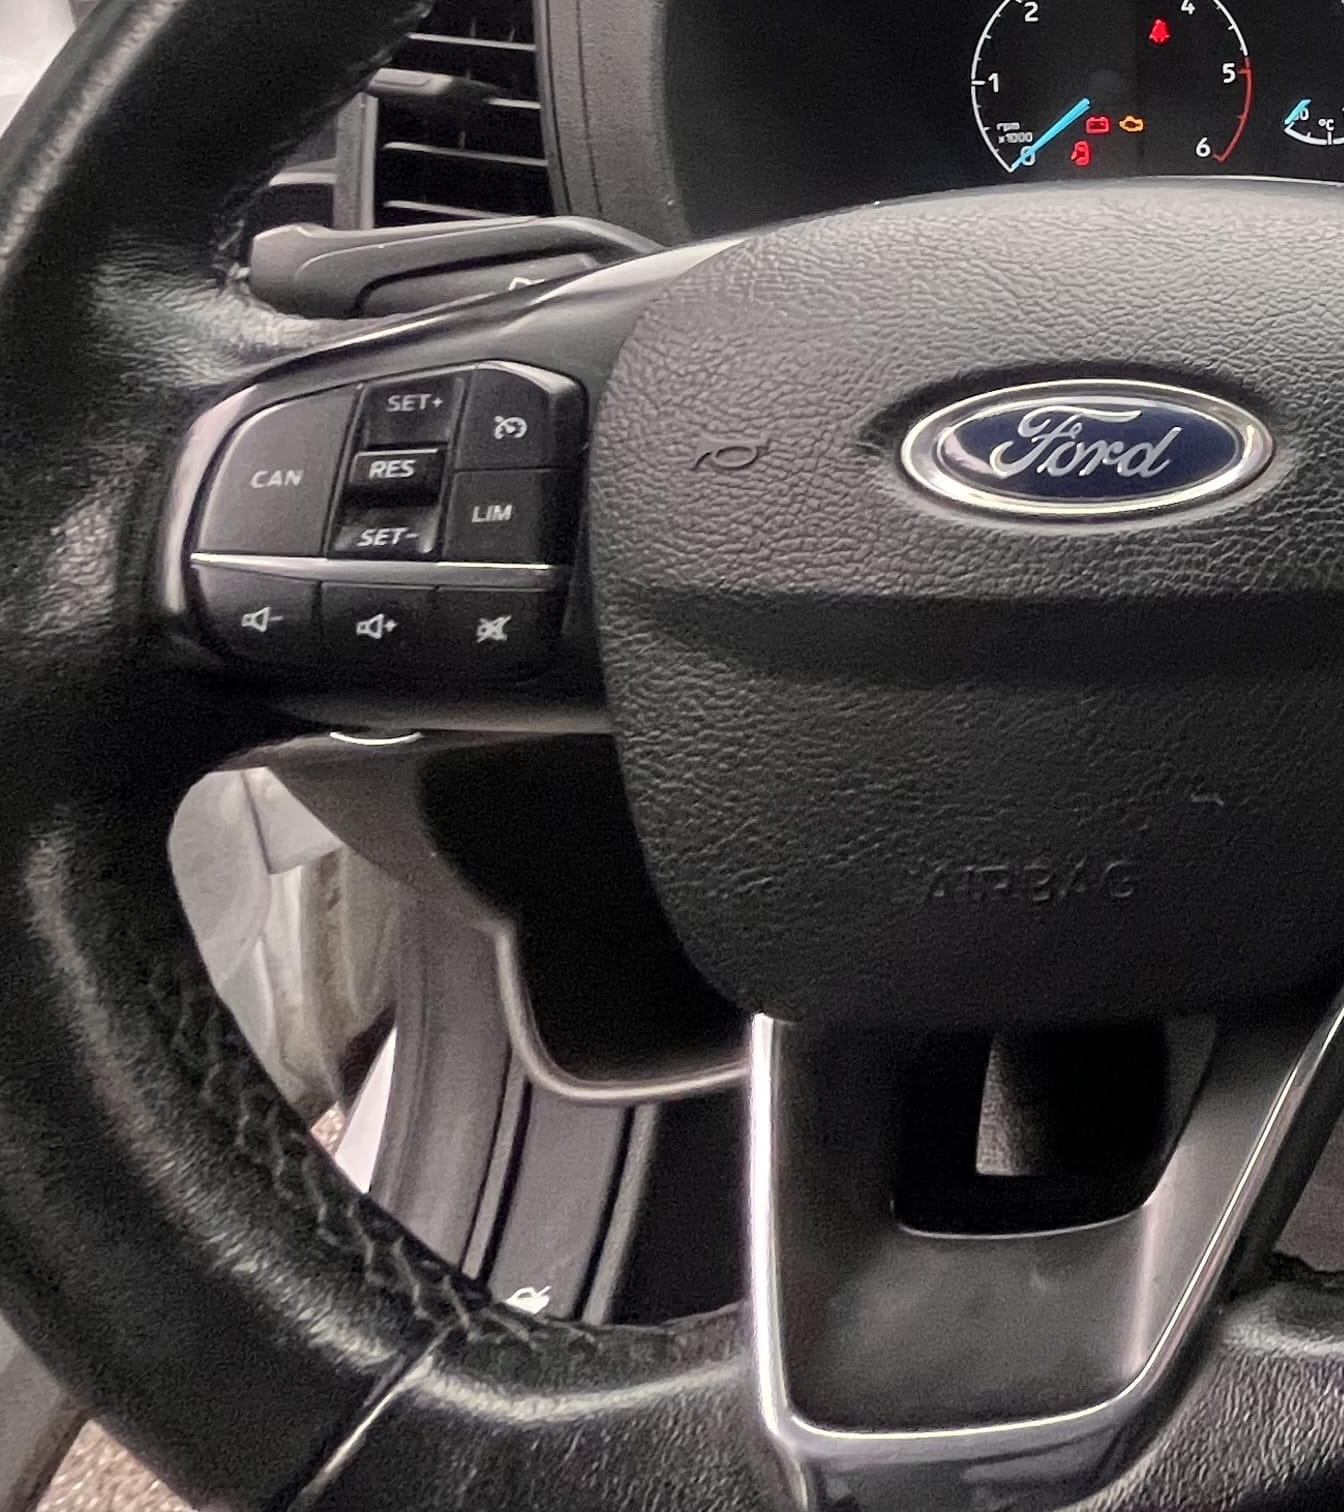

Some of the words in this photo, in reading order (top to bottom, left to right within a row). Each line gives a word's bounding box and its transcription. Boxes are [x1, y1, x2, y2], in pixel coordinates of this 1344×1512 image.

[1023, 1, 1039, 22] 2
[987, 72, 999, 93] 1
[1222, 62, 1236, 83] 5
[1020, 145, 1036, 166] 0
[1196, 137, 1211, 157] 6
[989, 404, 1183, 479] Ford
[251, 469, 304, 488] CAN
[369, 459, 416, 478] RES
[471, 504, 513, 523] LIM
